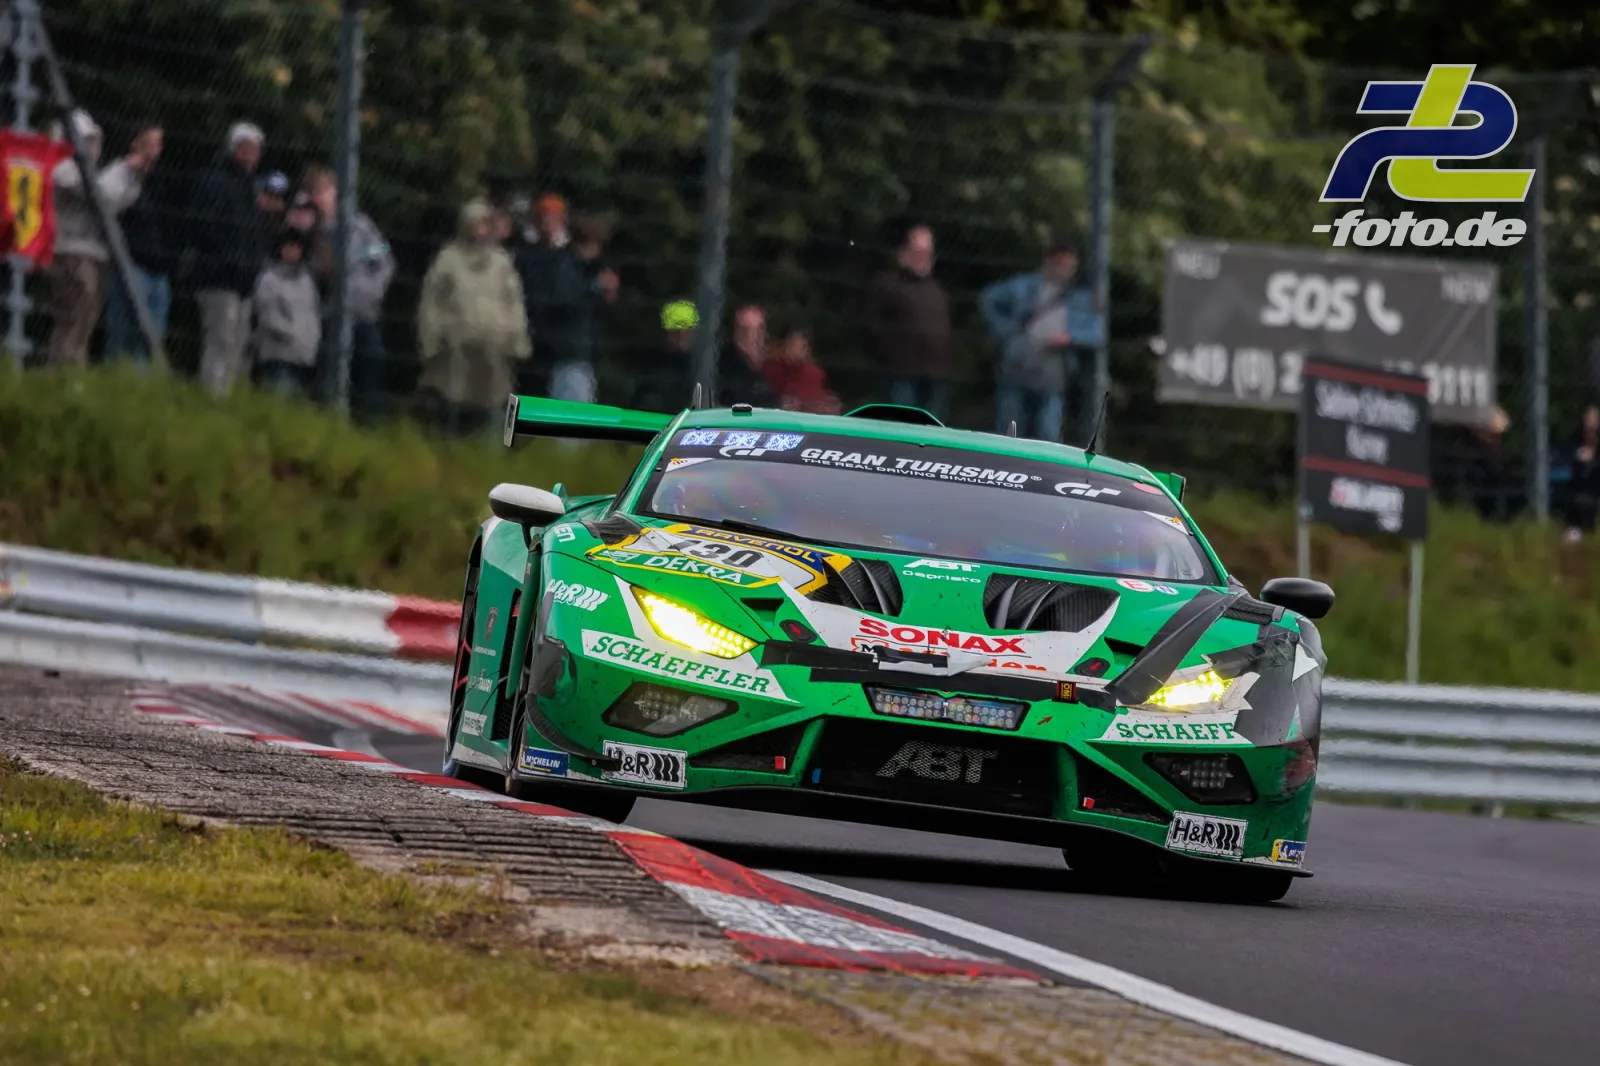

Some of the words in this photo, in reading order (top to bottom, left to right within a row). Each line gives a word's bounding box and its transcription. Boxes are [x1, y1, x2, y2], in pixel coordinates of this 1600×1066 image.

[1260, 270, 1360, 332] SOS
[800, 447, 888, 466] GRAN
[802, 457, 831, 466] THE
[834, 461, 873, 471] REAL
[876, 465, 937, 479] DRIVING
[940, 474, 1025, 490] SIMULATOR
[695, 528, 817, 563] RAVENOL
[643, 555, 743, 584] DEKRA
[904, 558, 981, 572] ABT
[859, 618, 1027, 654] SONAX
[591, 636, 770, 693] SCHAEFFLER
[1115, 721, 1235, 741] SCHAEFF
[525, 754, 561, 769] MICHELIN
[875, 740, 999, 783] ABT
